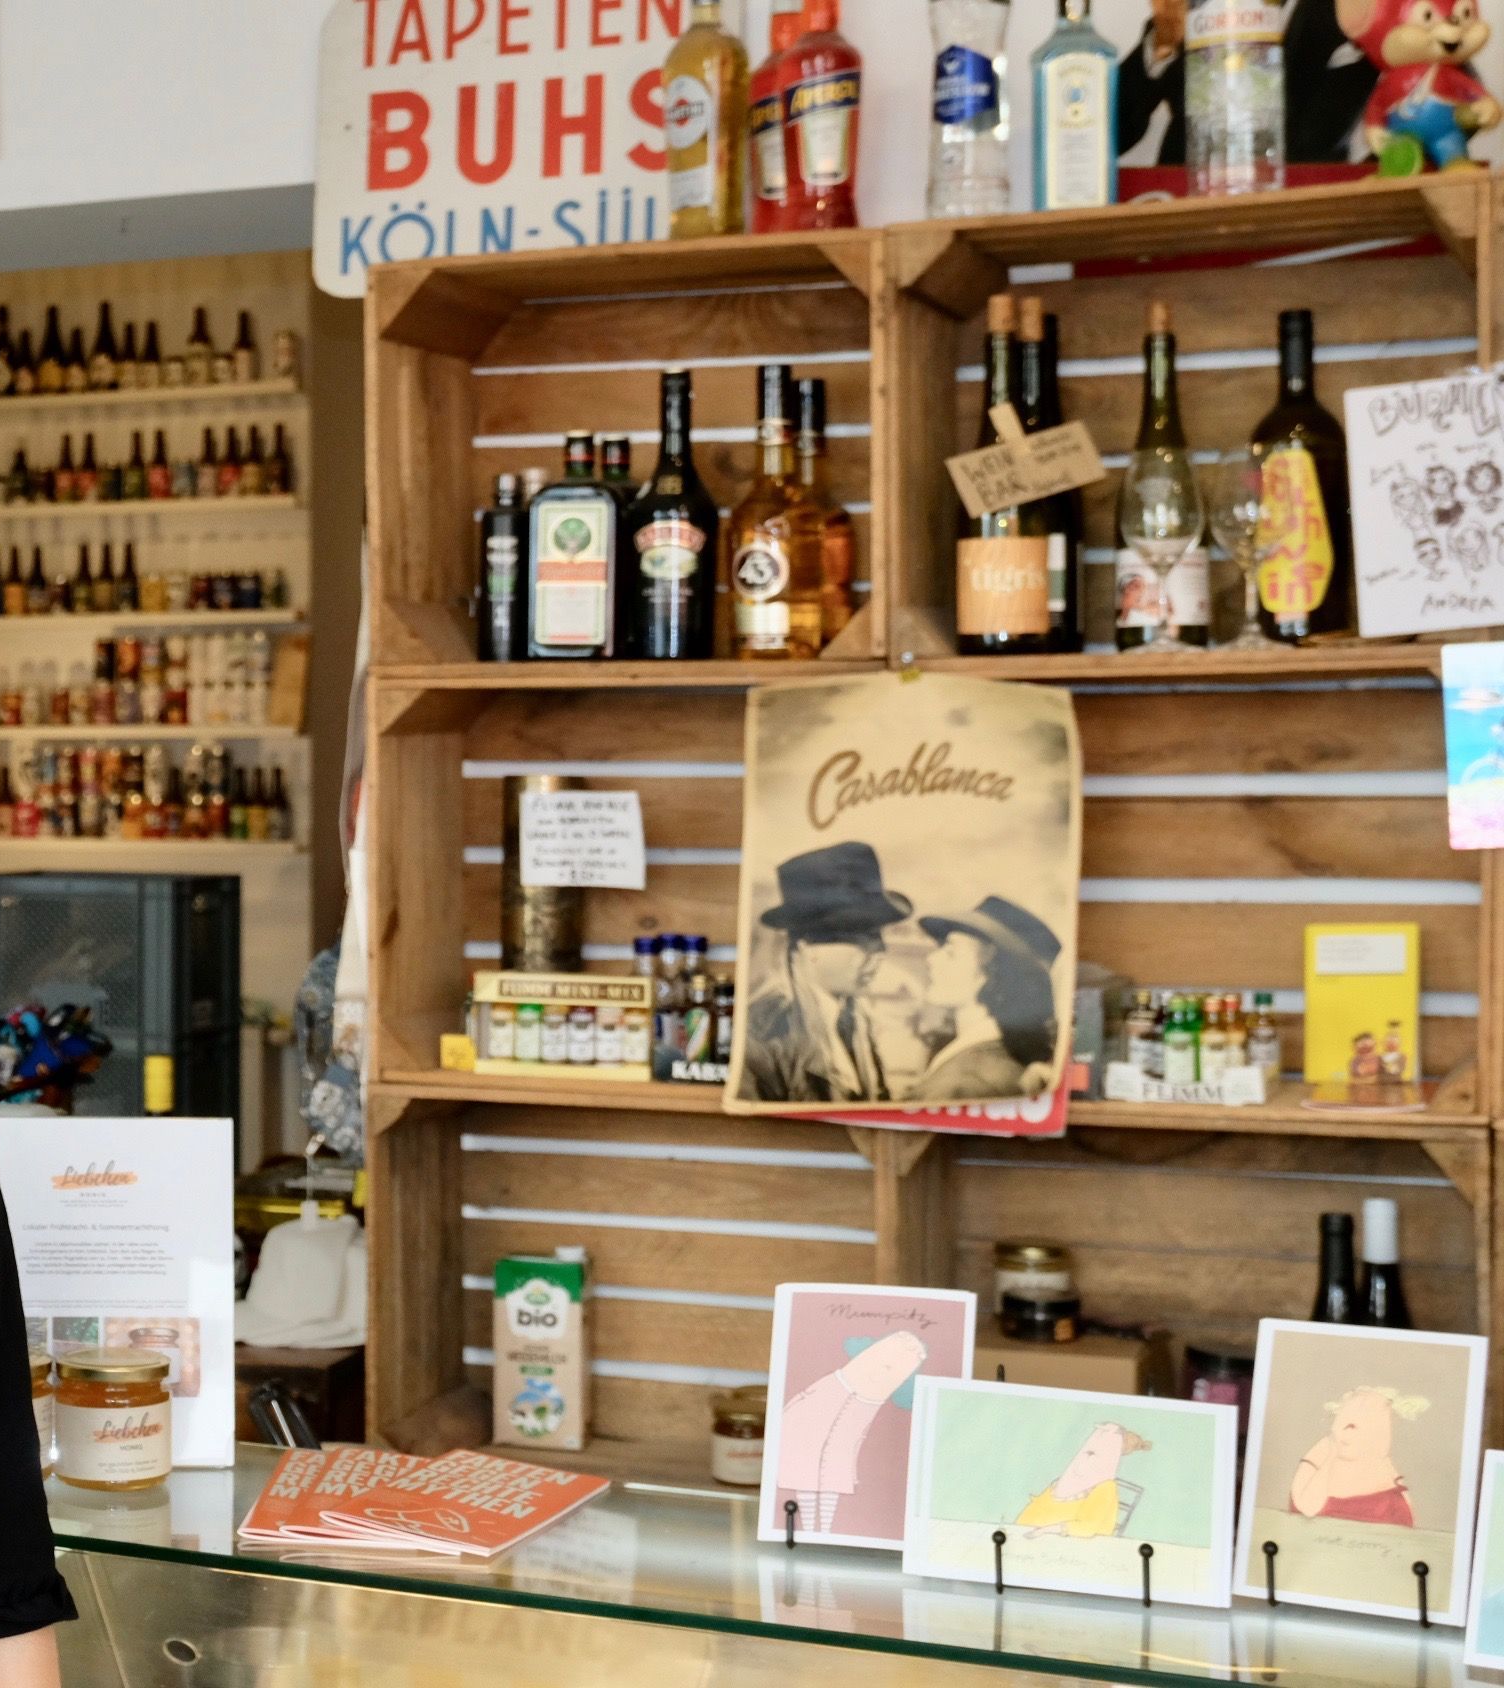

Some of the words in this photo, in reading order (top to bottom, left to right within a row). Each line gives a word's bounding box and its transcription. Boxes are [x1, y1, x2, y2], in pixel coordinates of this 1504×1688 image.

[354, 0, 683, 68] TAPETEN
[366, 68, 668, 191] BUHS
[807, 742, 1017, 831] Casablanca
[61, 1160, 131, 1187] Liebchen
[517, 1309, 558, 1327] bio
[98, 1412, 160, 1441] Liebchen
[428, 1460, 542, 1491] GEGEN
[447, 1450, 578, 1486] FAKTEN
[387, 1476, 537, 1520] MYTHEN
